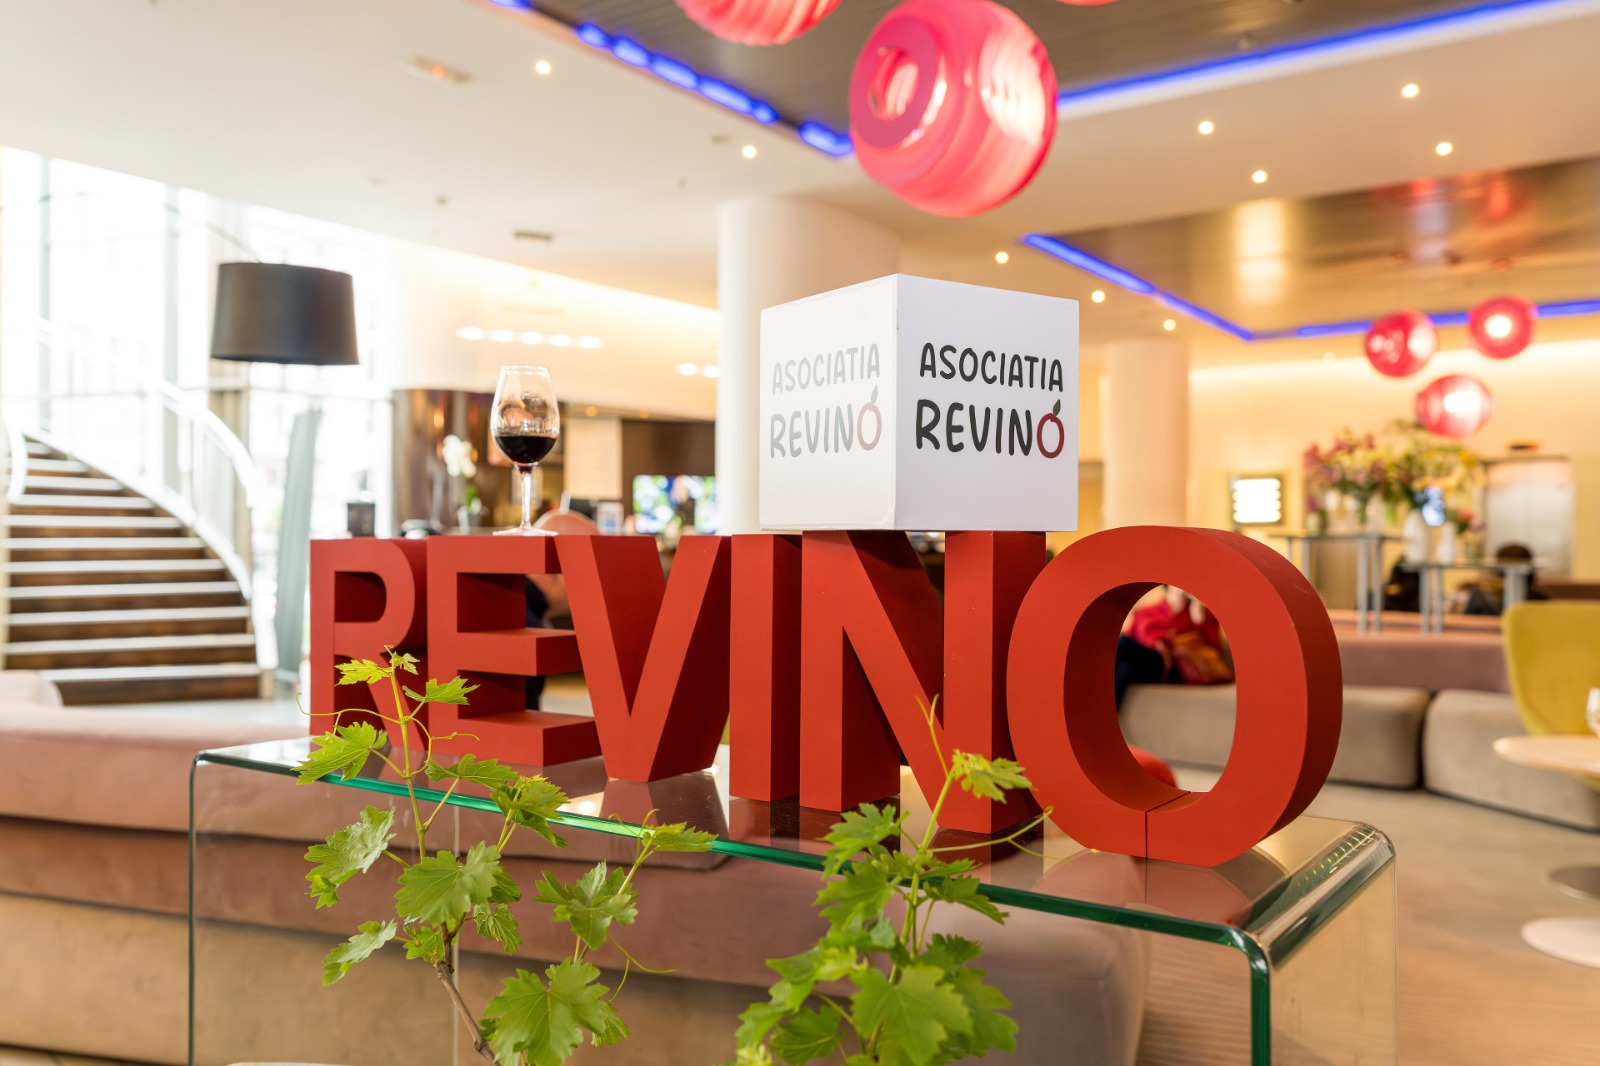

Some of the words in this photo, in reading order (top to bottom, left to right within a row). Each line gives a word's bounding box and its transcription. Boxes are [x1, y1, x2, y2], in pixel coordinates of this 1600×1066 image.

[772, 343, 880, 395] ASOCIATIA
[919, 342, 1063, 392] ASOCIATIA
[770, 400, 882, 459] REVINO
[915, 399, 1065, 459] REVINO
[310, 526, 1342, 866] REVINO
